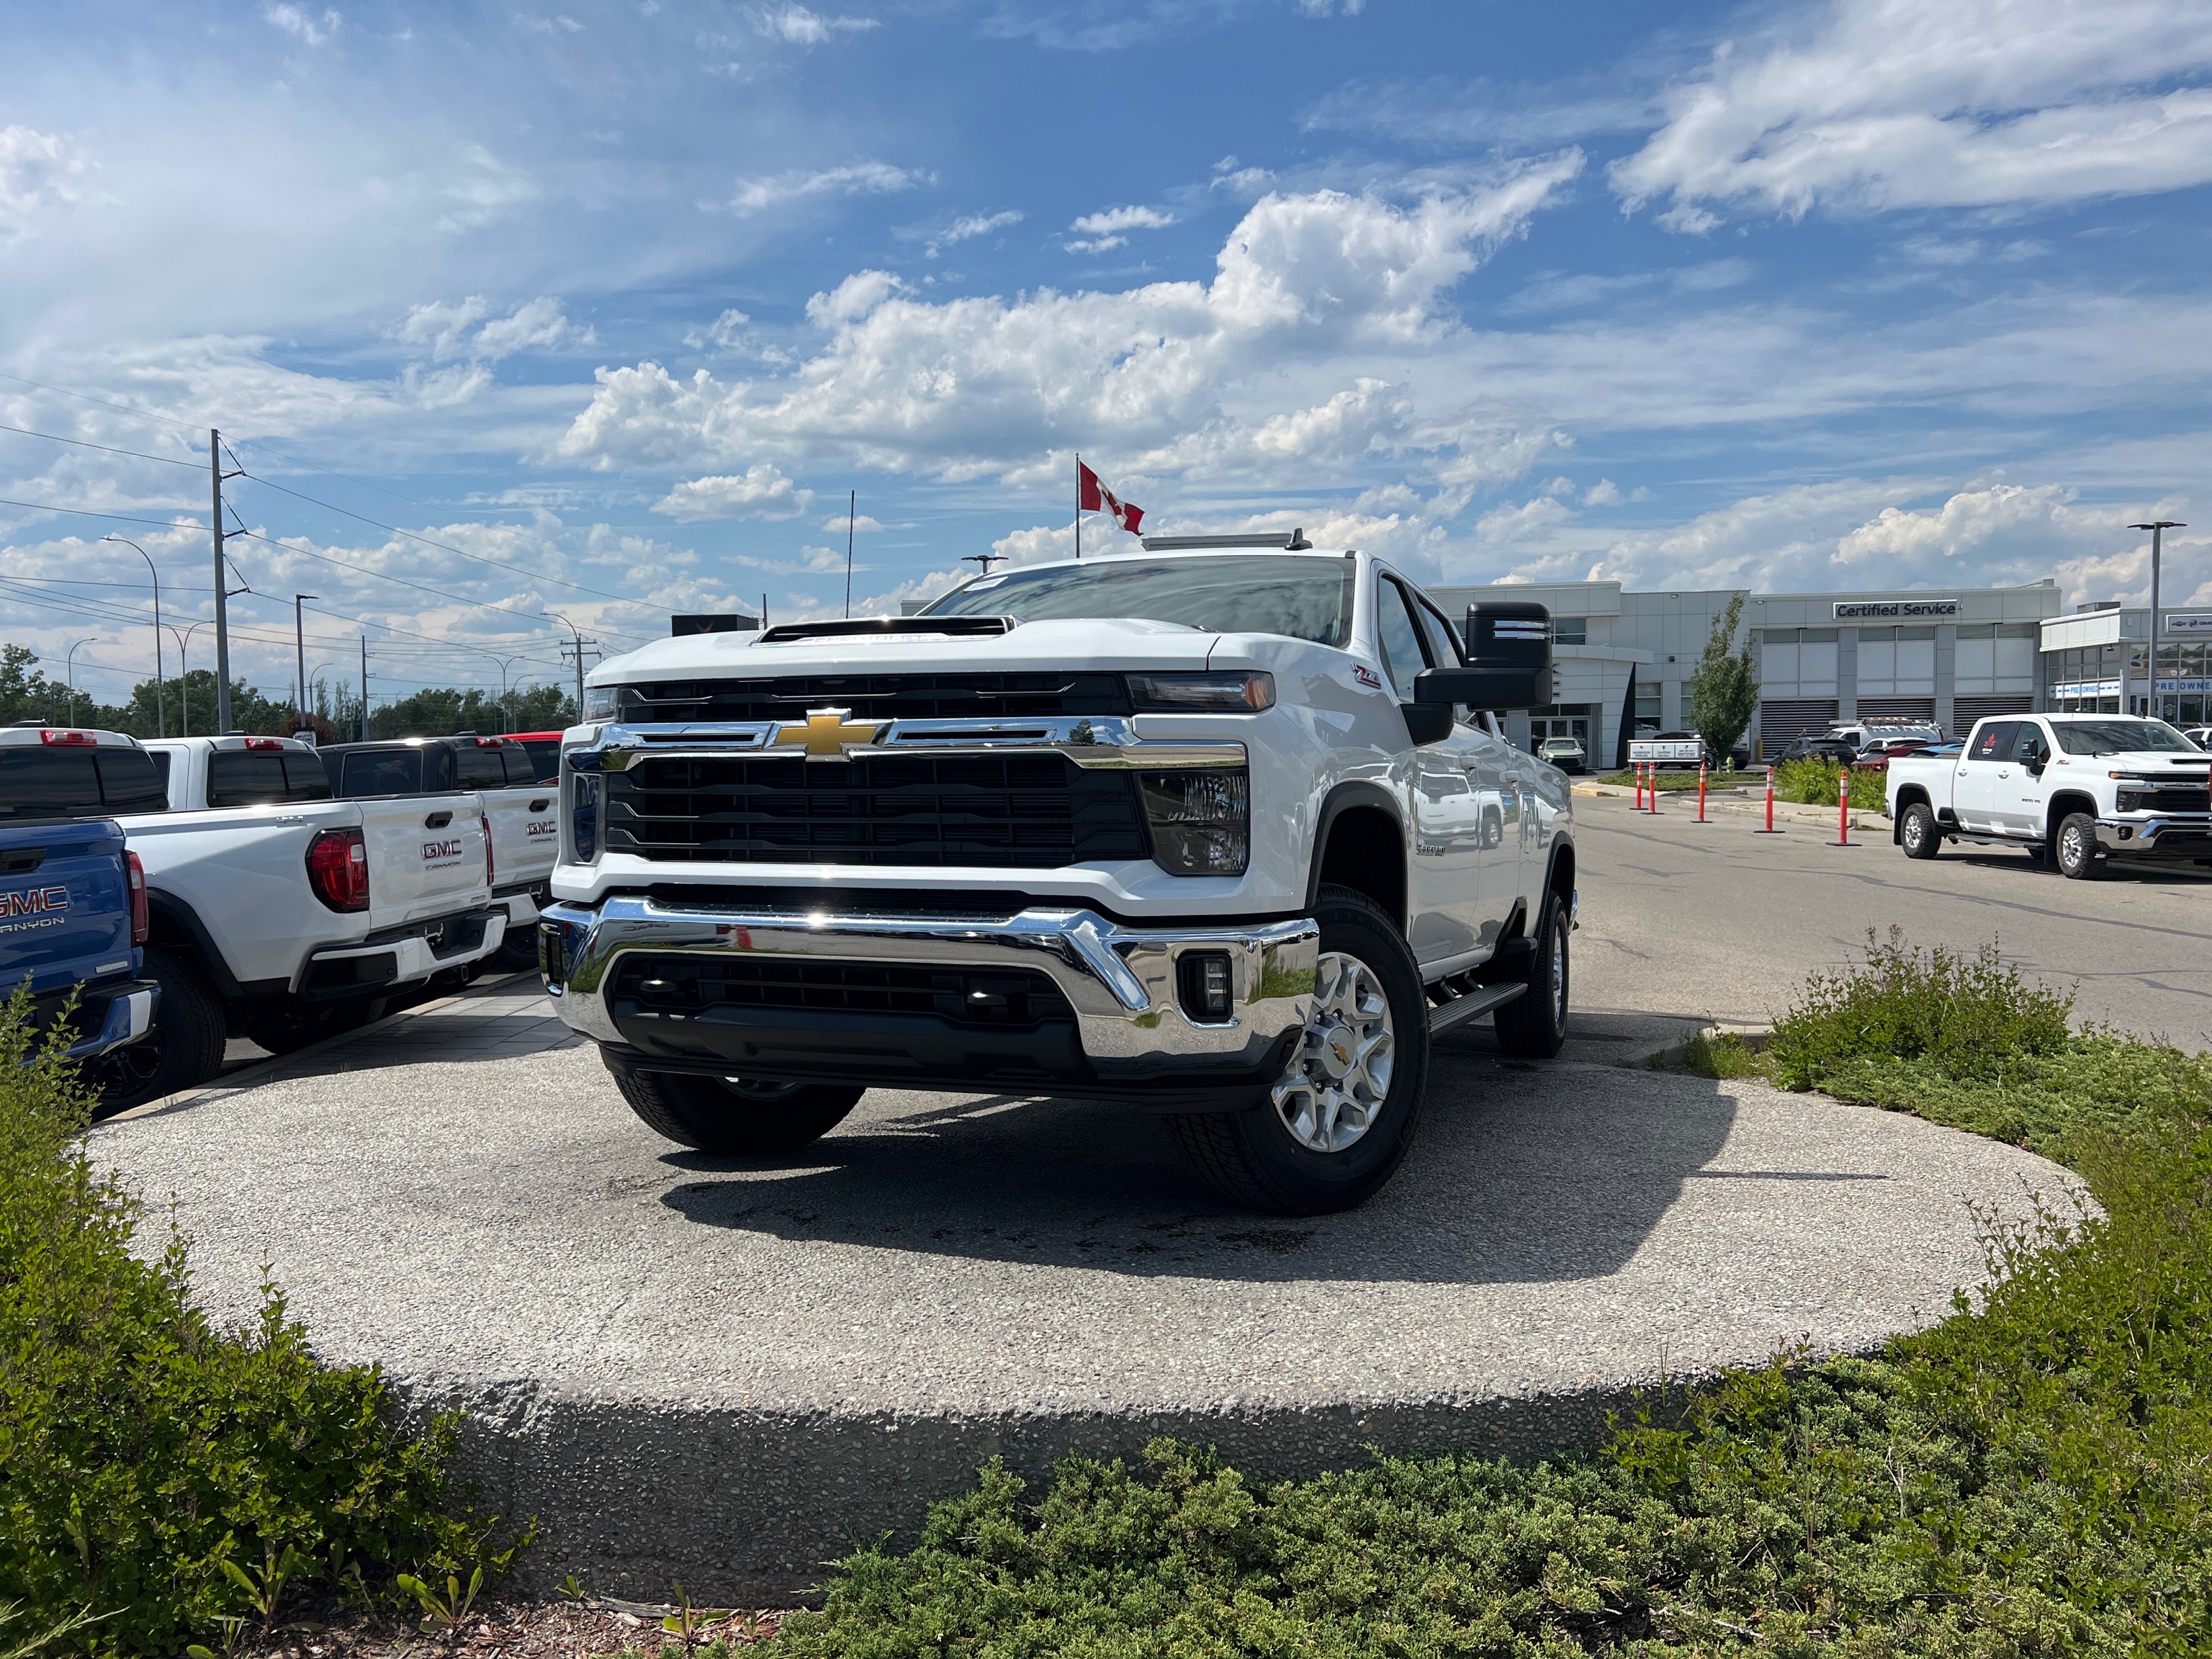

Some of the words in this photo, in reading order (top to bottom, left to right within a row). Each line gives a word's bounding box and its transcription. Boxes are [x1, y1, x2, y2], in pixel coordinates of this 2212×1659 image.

[1838, 603, 1898, 617] Certified
[1904, 603, 1956, 615] Service
[526, 821, 557, 835] GMC
[422, 839, 462, 860] GMC
[0, 917, 65, 934] ANYON
